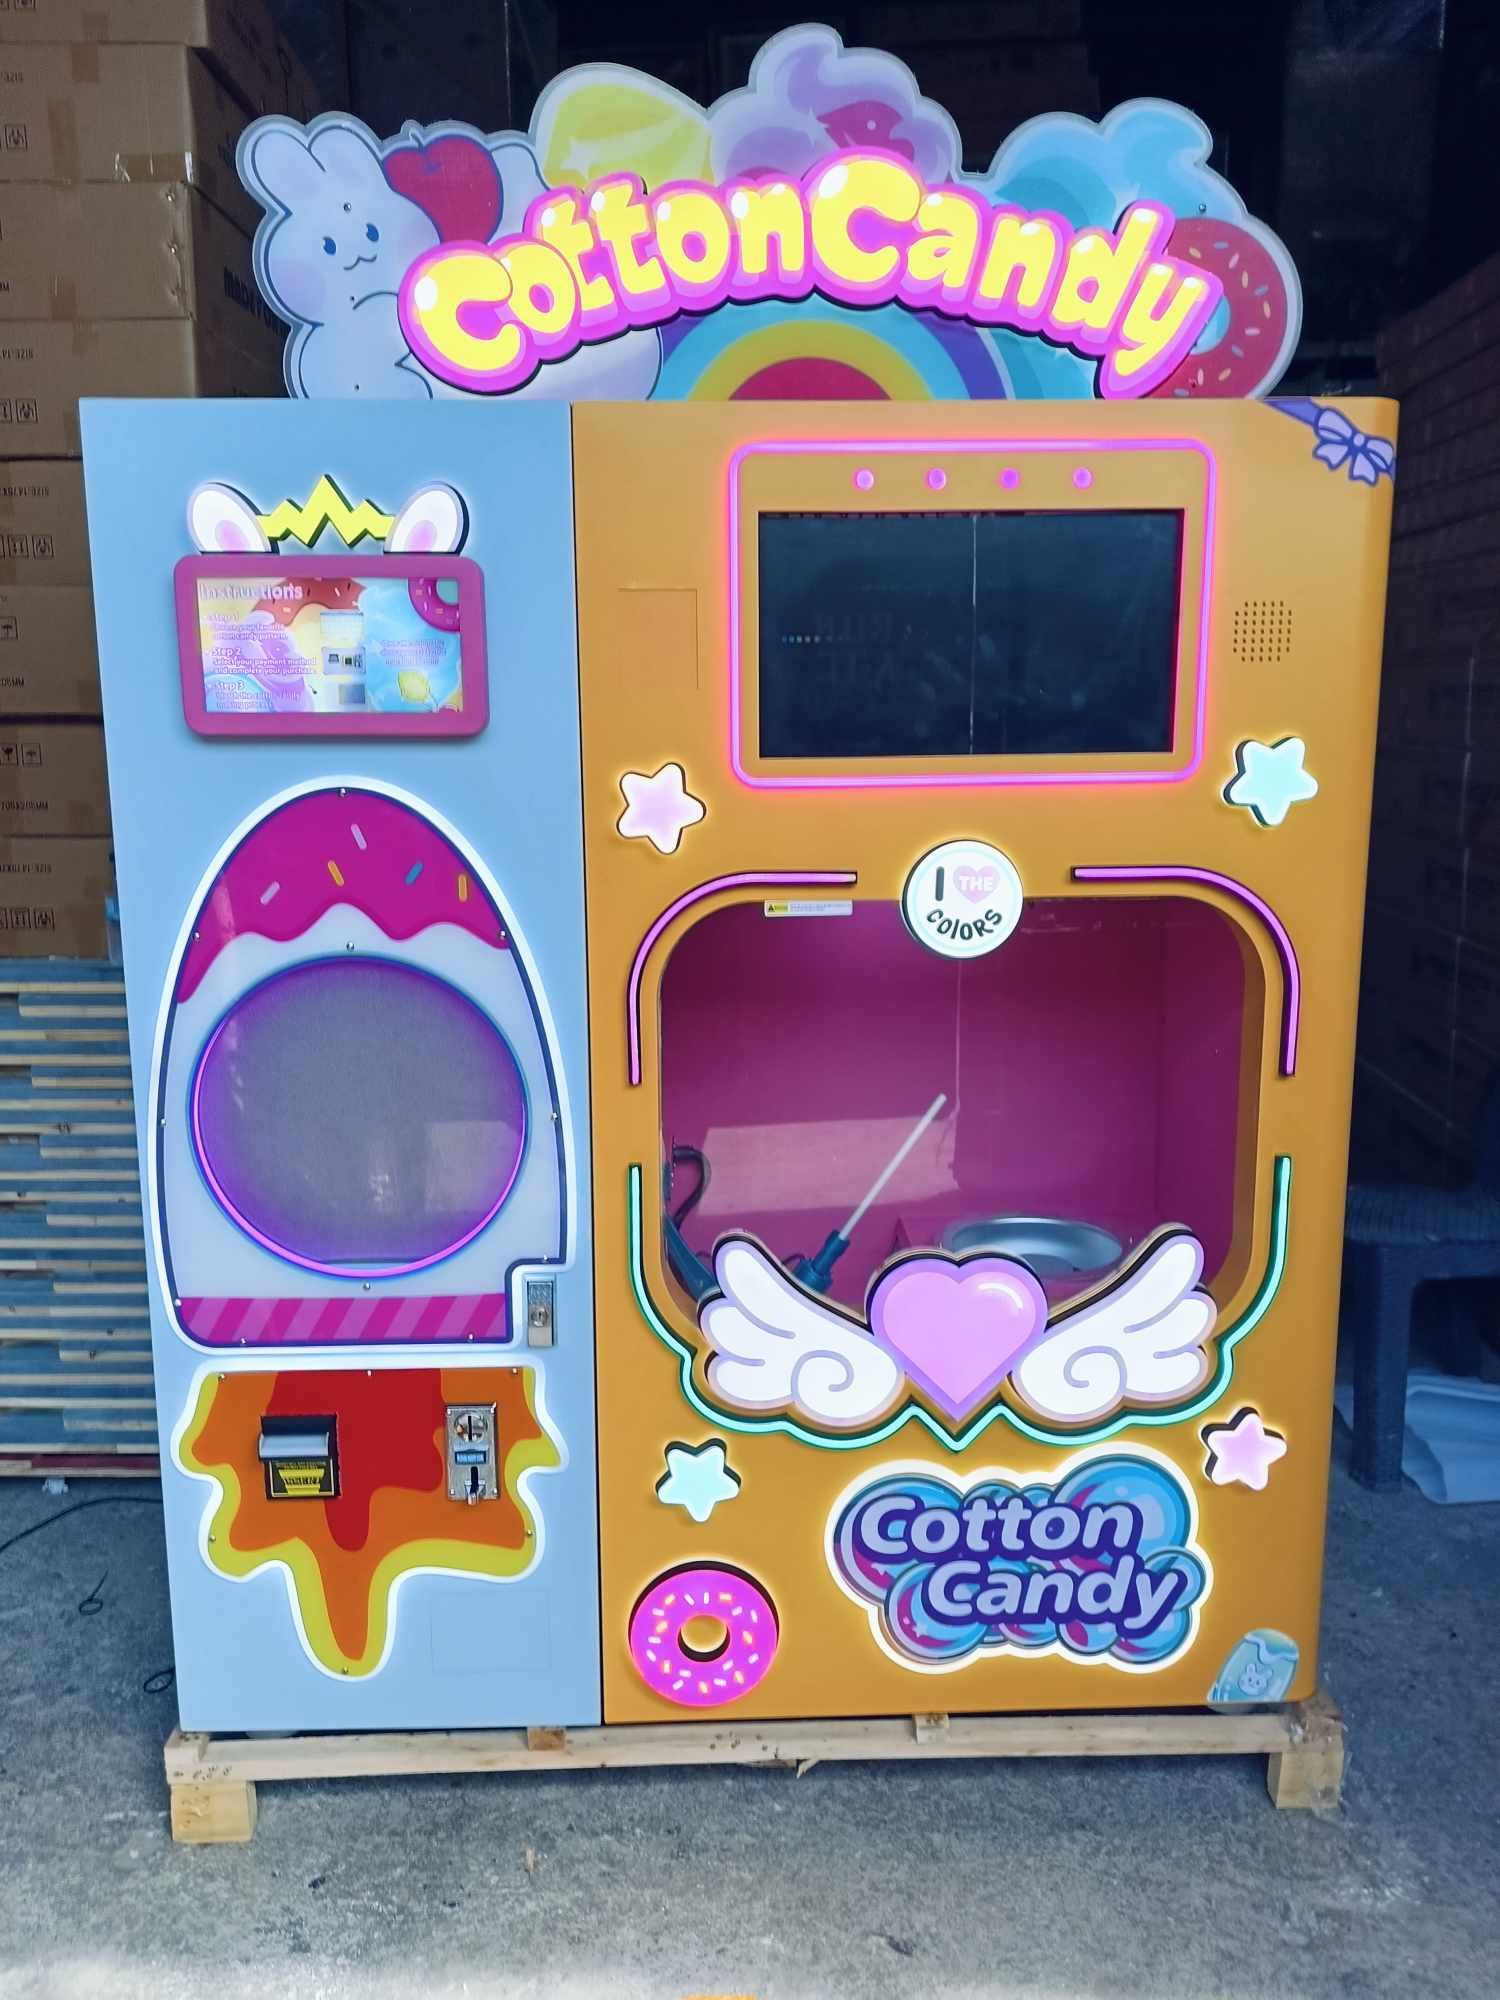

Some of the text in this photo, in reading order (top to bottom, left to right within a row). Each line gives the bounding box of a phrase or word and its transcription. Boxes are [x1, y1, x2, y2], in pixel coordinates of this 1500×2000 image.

[200, 583, 303, 600] Instructions
[211, 647, 241, 658] Step 2
[237, 659, 253, 667] your
[255, 658, 286, 667] payment
[215, 681, 235, 692] Step
[935, 866, 994, 901] I THE
[857, 1495, 1136, 1556] Cotton
[925, 1553, 1180, 1630] Candy
